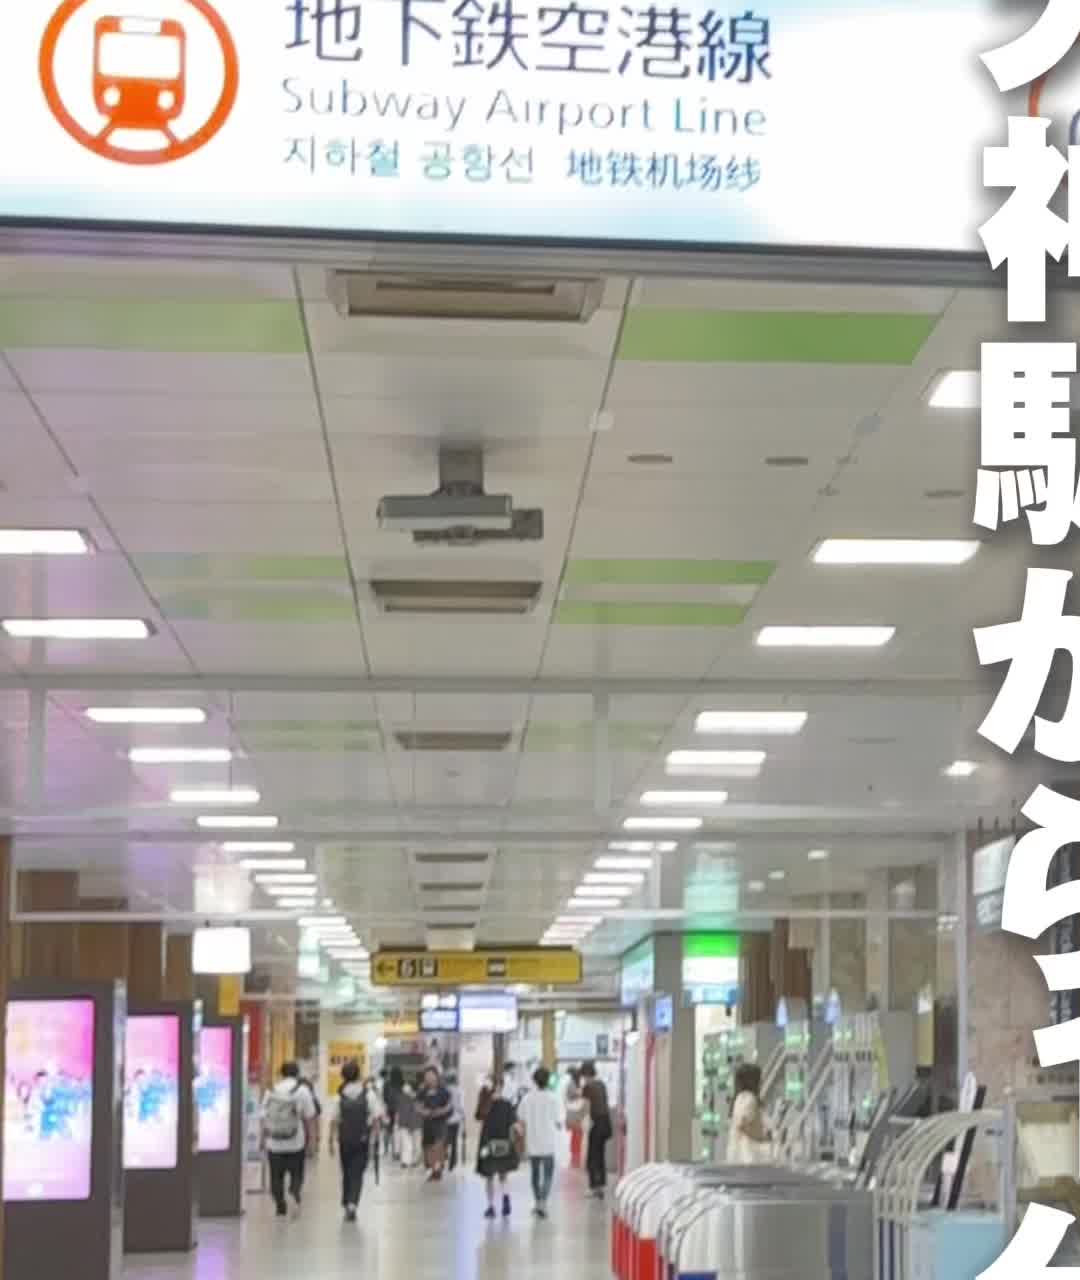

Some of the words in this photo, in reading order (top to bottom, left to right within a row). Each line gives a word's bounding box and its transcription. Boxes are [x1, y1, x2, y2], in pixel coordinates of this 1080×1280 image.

[282, 77, 467, 132] Subway
[486, 88, 657, 136] Airport
[673, 96, 768, 137] Line
[283, 135, 400, 178] 지하철
[420, 140, 534, 185] 공항선
[567, 148, 762, 193] 地铁机场线
